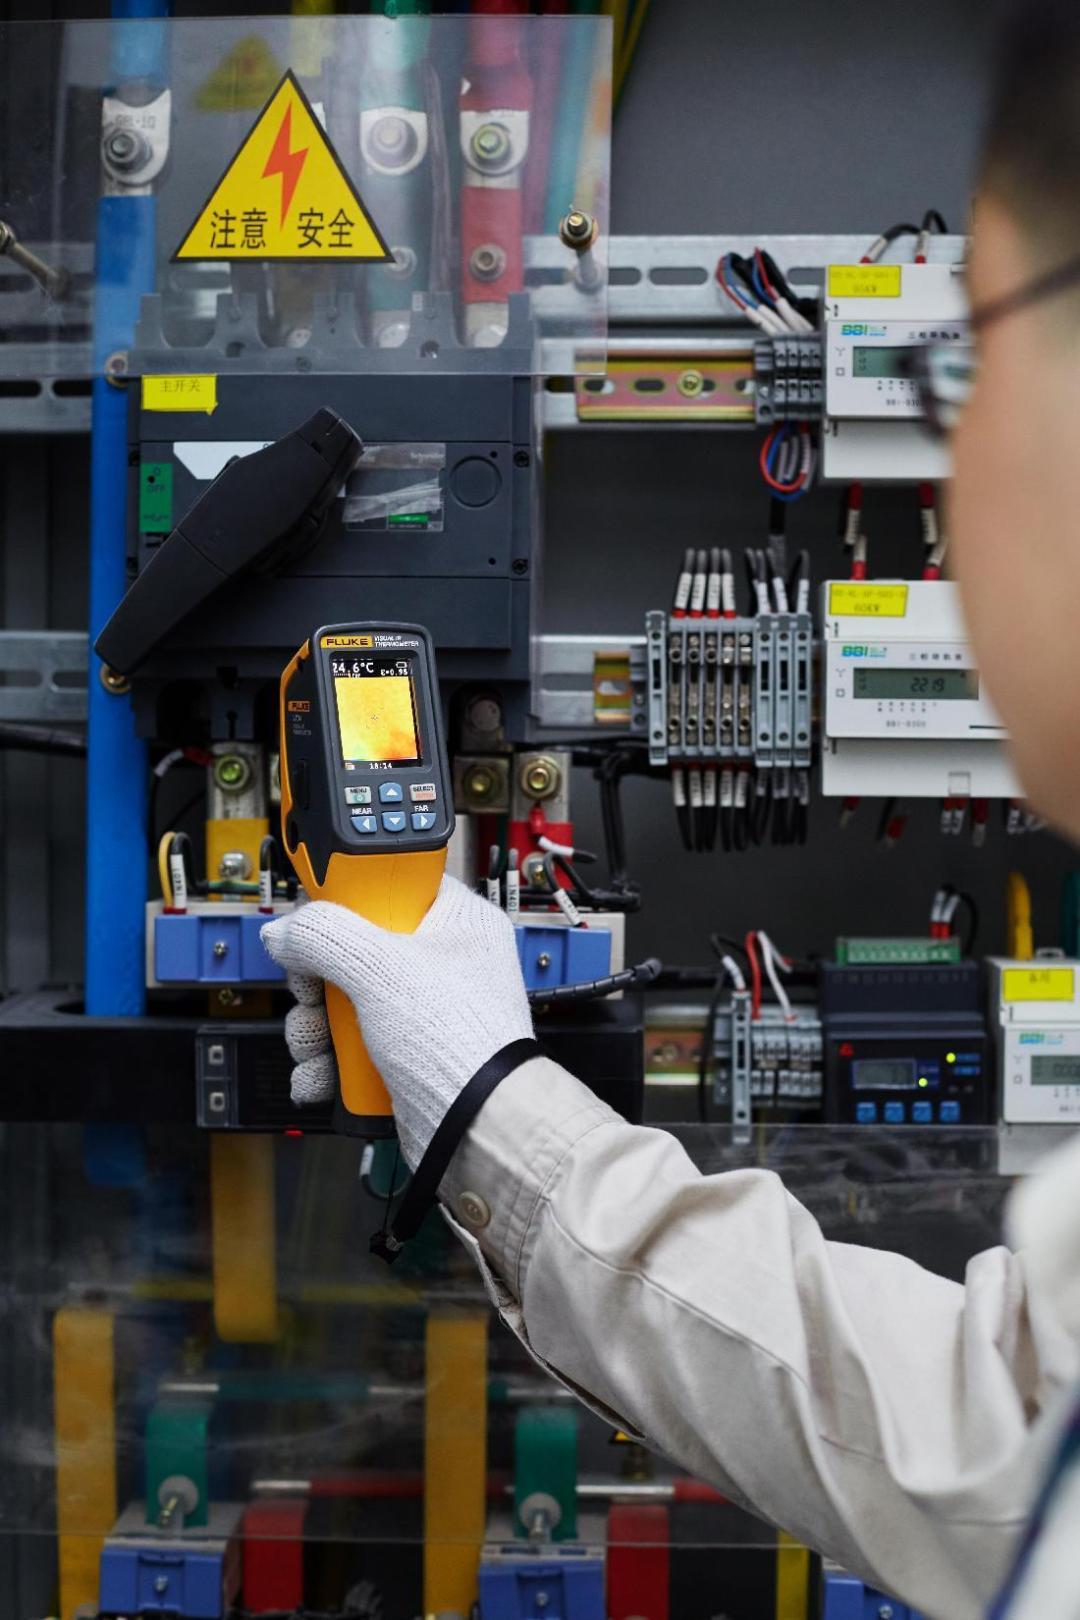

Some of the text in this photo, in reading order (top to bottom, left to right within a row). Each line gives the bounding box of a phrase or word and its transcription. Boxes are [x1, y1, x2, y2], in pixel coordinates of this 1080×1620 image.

[209, 207, 355, 249] 注意 安全
[160, 379, 201, 393] 主开关
[326, 638, 369, 646] FLUKE
[332, 662, 374, 673] 24.6°C
[351, 807, 373, 815] NEAR
[414, 804, 429, 812] FAR
